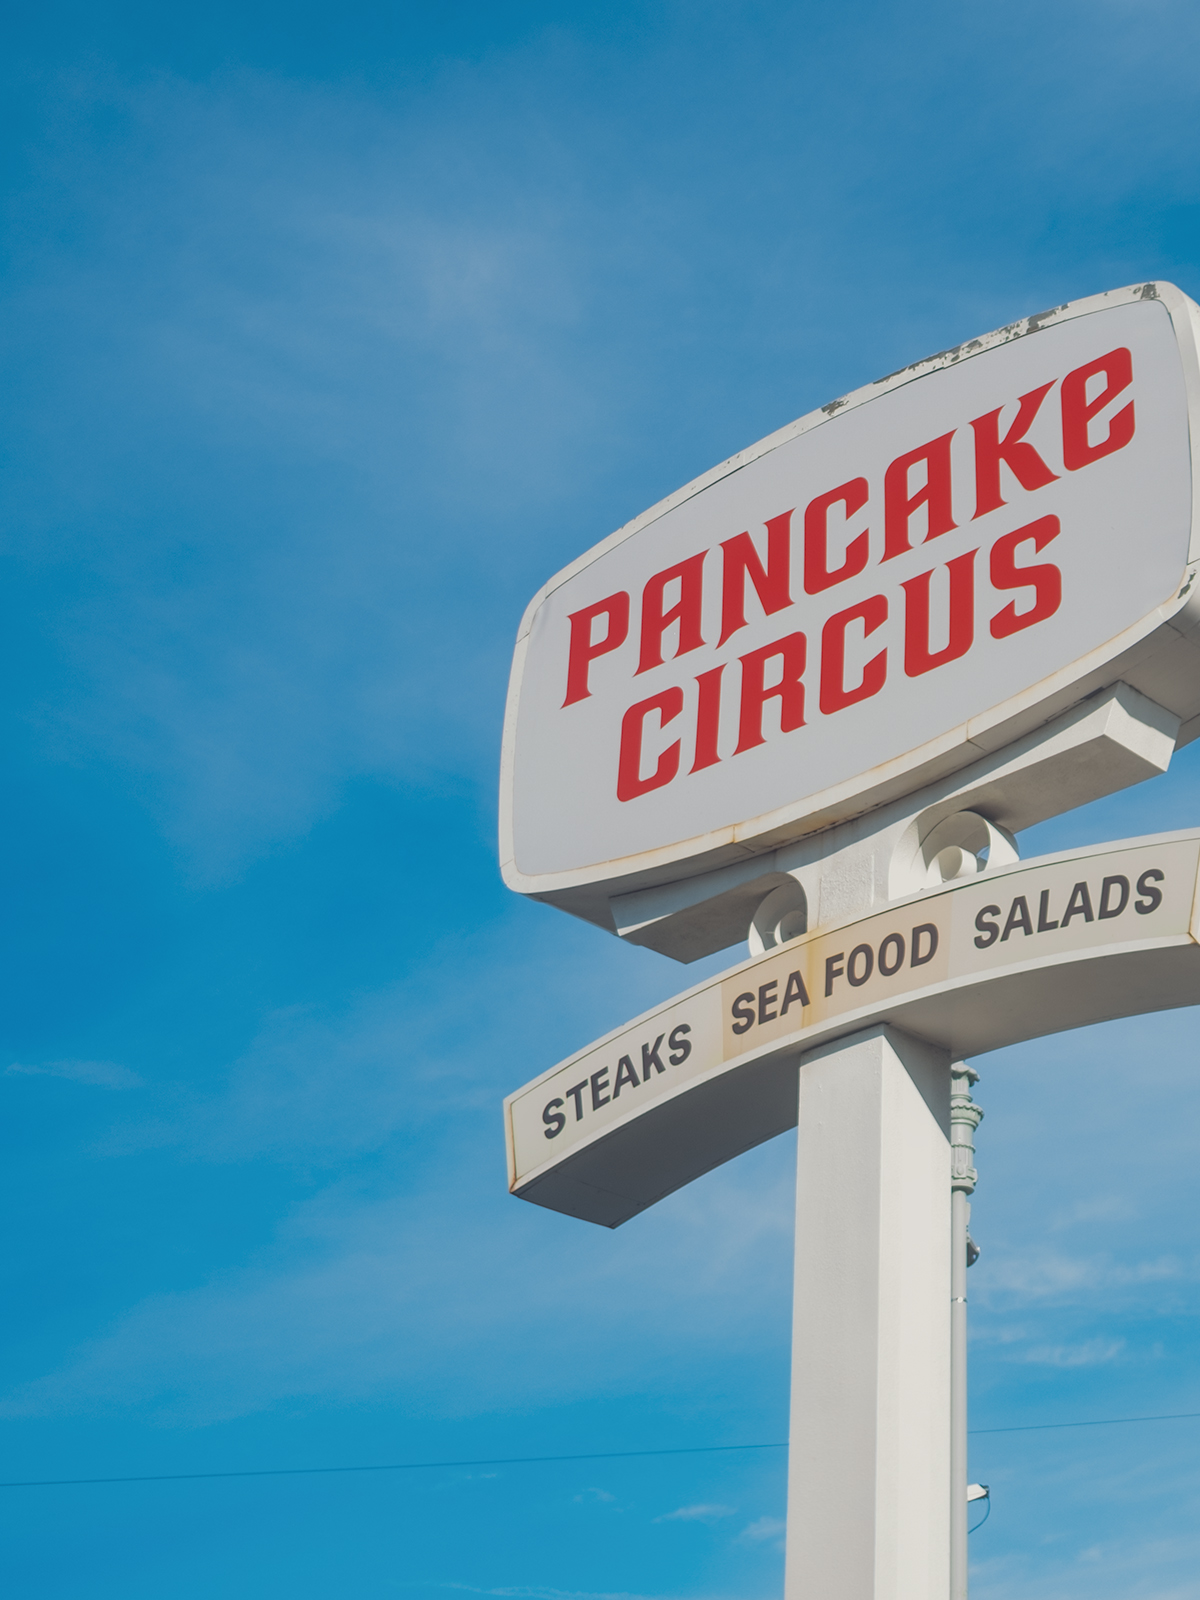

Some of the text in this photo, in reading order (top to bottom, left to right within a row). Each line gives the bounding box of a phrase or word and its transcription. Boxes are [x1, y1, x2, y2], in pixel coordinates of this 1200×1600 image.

[561, 347, 1136, 709] PANCAKE
[615, 514, 1062, 803] CIRCUS
[540, 868, 1165, 1140] STEAKS SEA FOOD SALADS
